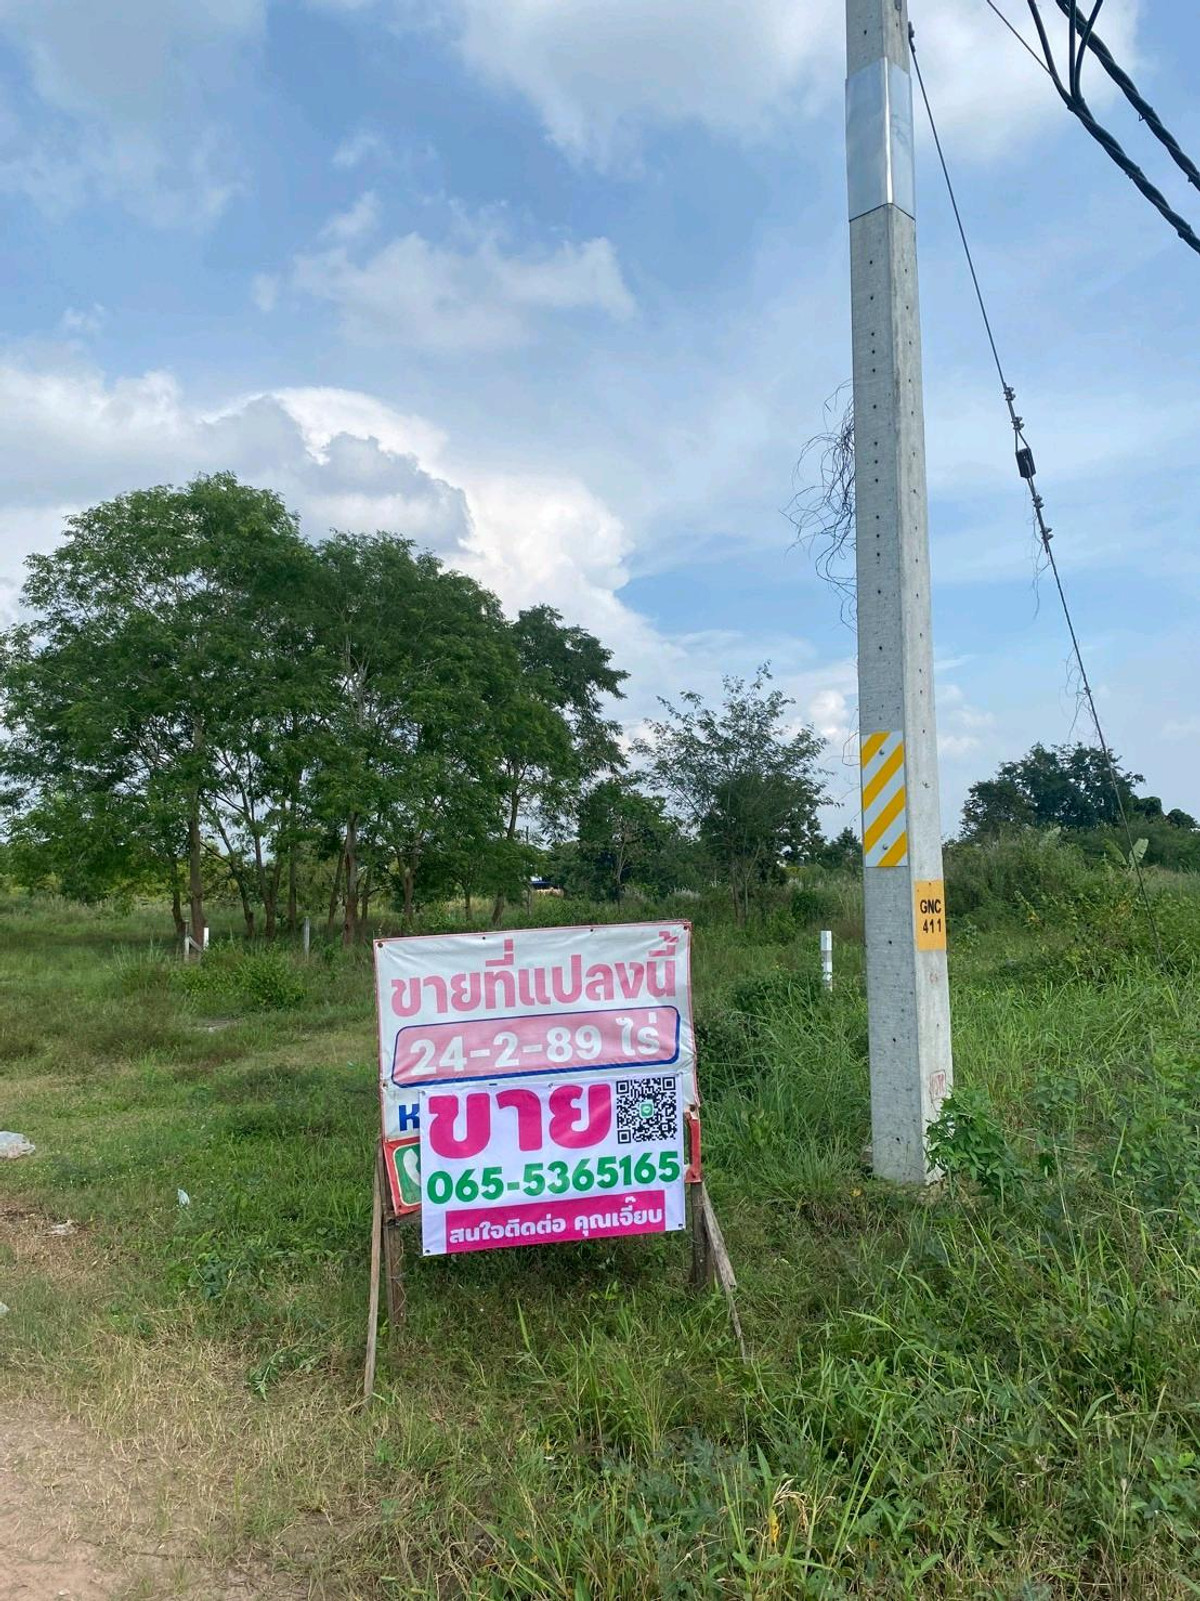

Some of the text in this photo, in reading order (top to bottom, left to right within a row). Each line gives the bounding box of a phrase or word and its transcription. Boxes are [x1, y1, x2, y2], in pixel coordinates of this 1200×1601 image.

[920, 898, 942, 914] GNC
[922, 918, 942, 934] 411
[391, 931, 679, 1017] ขายที่แปลงนี้
[409, 1012, 660, 1076] 24-2-89 ไร่
[428, 1083, 612, 1159] ขาย
[426, 1150, 681, 1205] 065-5365165
[449, 1195, 664, 1244] สนใจติดต่อ คุณเจี๊ยบ
